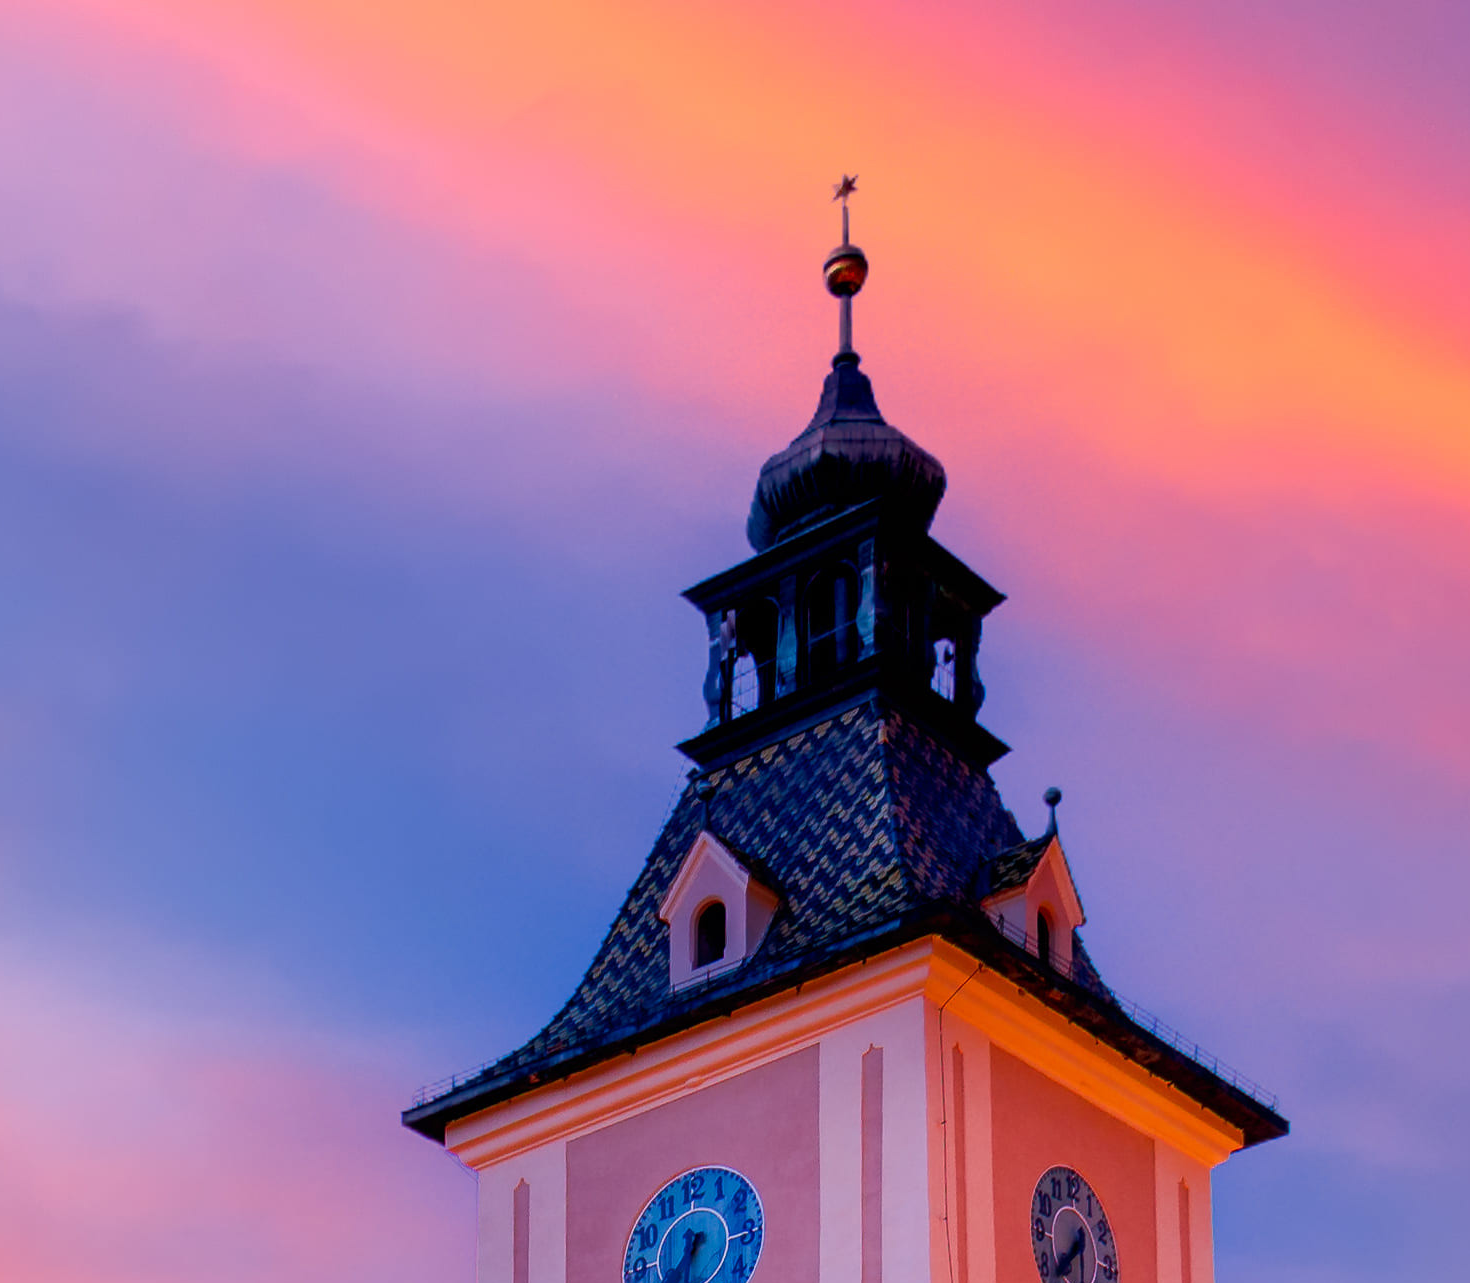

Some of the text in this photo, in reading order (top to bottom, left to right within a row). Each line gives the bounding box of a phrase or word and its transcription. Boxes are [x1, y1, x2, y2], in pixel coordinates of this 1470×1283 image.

[682, 1176, 706, 1204] 12
[715, 1176, 725, 1201] 1
[732, 1187, 747, 1214] 2
[1051, 1177, 1062, 1201] 11
[1066, 1175, 1080, 1202] 12
[660, 1195, 675, 1220] 11
[1038, 1189, 1051, 1218] 10
[1086, 1194, 1092, 1218] 1
[634, 1223, 658, 1251] 10
[740, 1218, 755, 1245] 3
[1035, 1217, 1045, 1242] 9
[1097, 1219, 1107, 1245] 2
[633, 1257, 647, 1281] 9
[732, 1254, 747, 1278] 4
[1040, 1252, 1049, 1278] 8
[1103, 1255, 1112, 1280] 3
